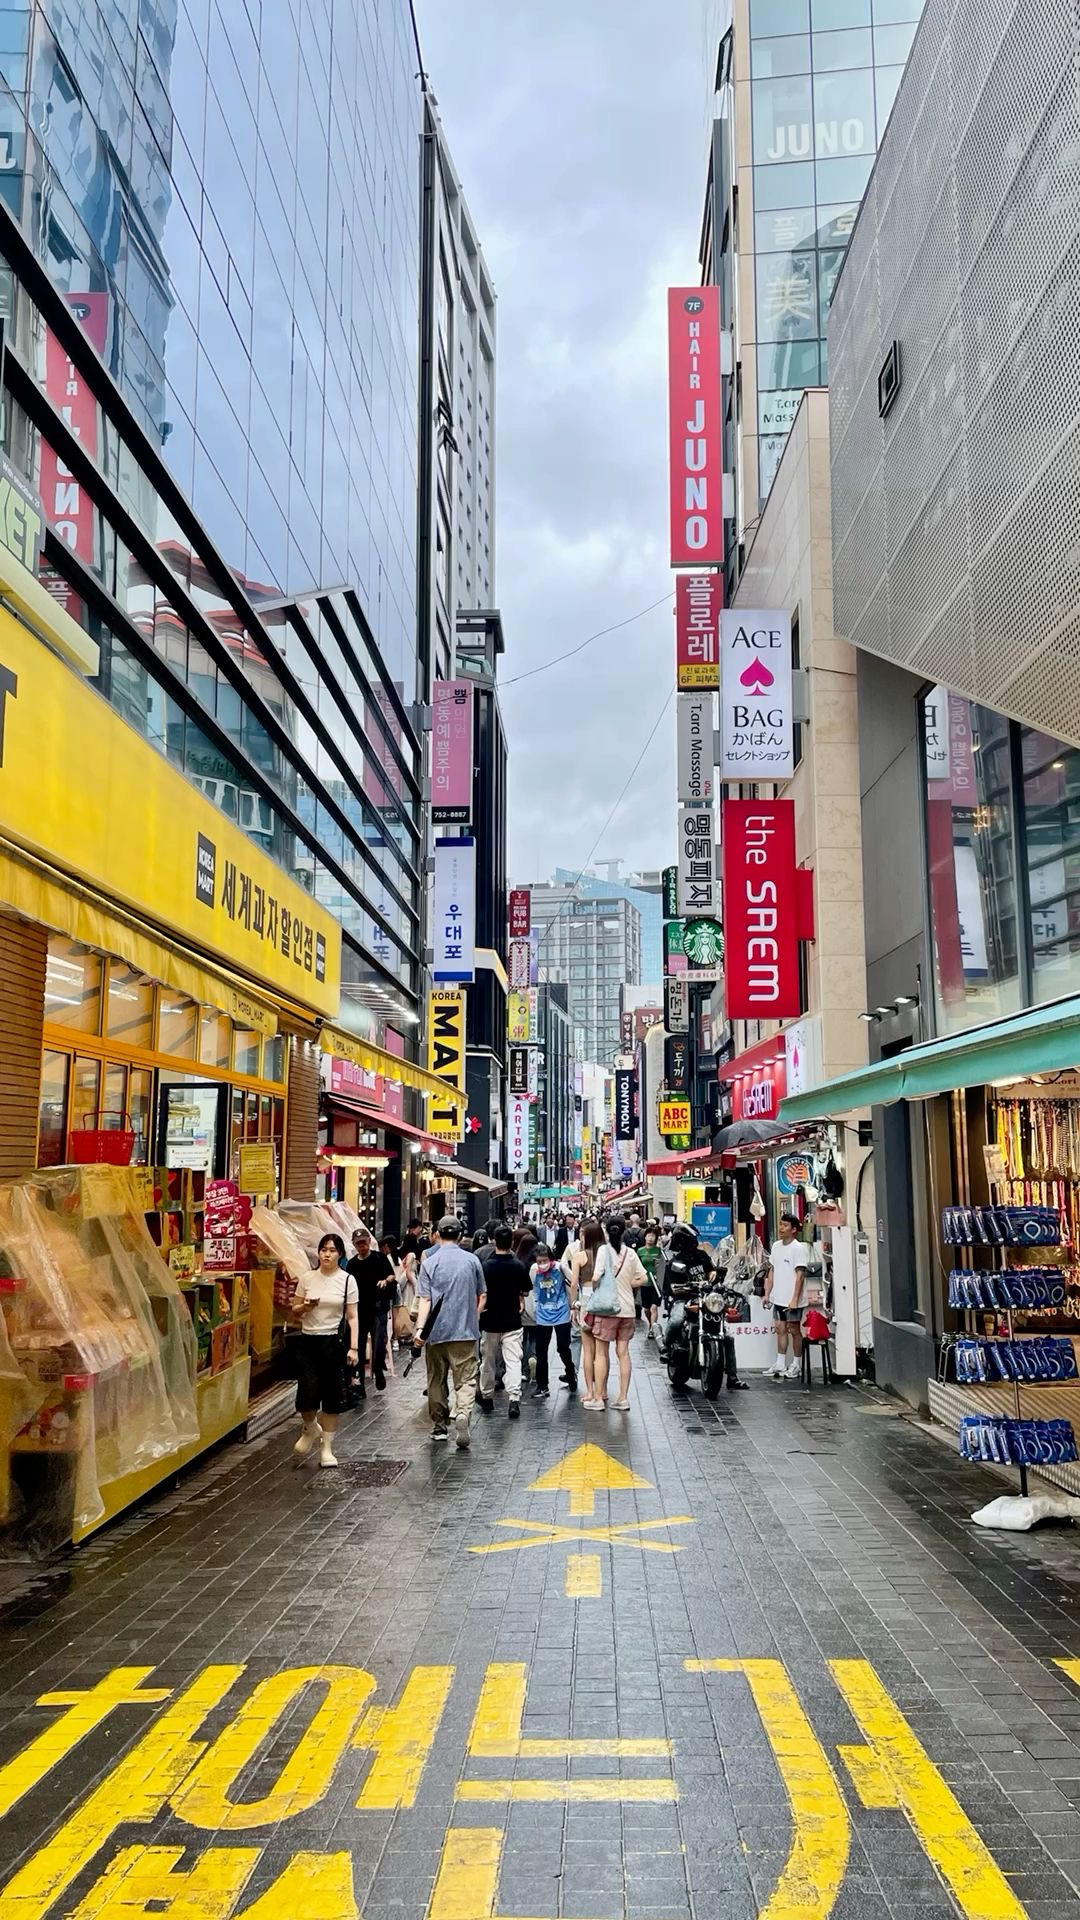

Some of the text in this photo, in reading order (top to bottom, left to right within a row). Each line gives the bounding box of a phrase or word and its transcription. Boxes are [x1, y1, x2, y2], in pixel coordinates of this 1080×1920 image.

[767, 118, 865, 160] JUNO
[687, 300, 701, 311] 7F
[685, 322, 709, 551] HAIR JUNO
[731, 627, 782, 648] ACE
[681, 675, 692, 684] 6F
[732, 706, 784, 728] BAG
[732, 732, 783, 745] かばん
[689, 704, 702, 797] T.ara Massage
[725, 750, 791, 761] セレクトショップ
[704, 781, 711, 796] 5F
[745, 815, 775, 865] the
[684, 815, 712, 909] 명동피자
[222, 860, 314, 973] 세계과자할인점
[444, 904, 462, 960] 우대포
[432, 992, 462, 1001] KOREA
[620, 1076, 631, 1135] TONYMOLY
[663, 1107, 688, 1120] ABC
[514, 1103, 523, 1159] ARTBOX
[663, 1120, 689, 1129] MART
